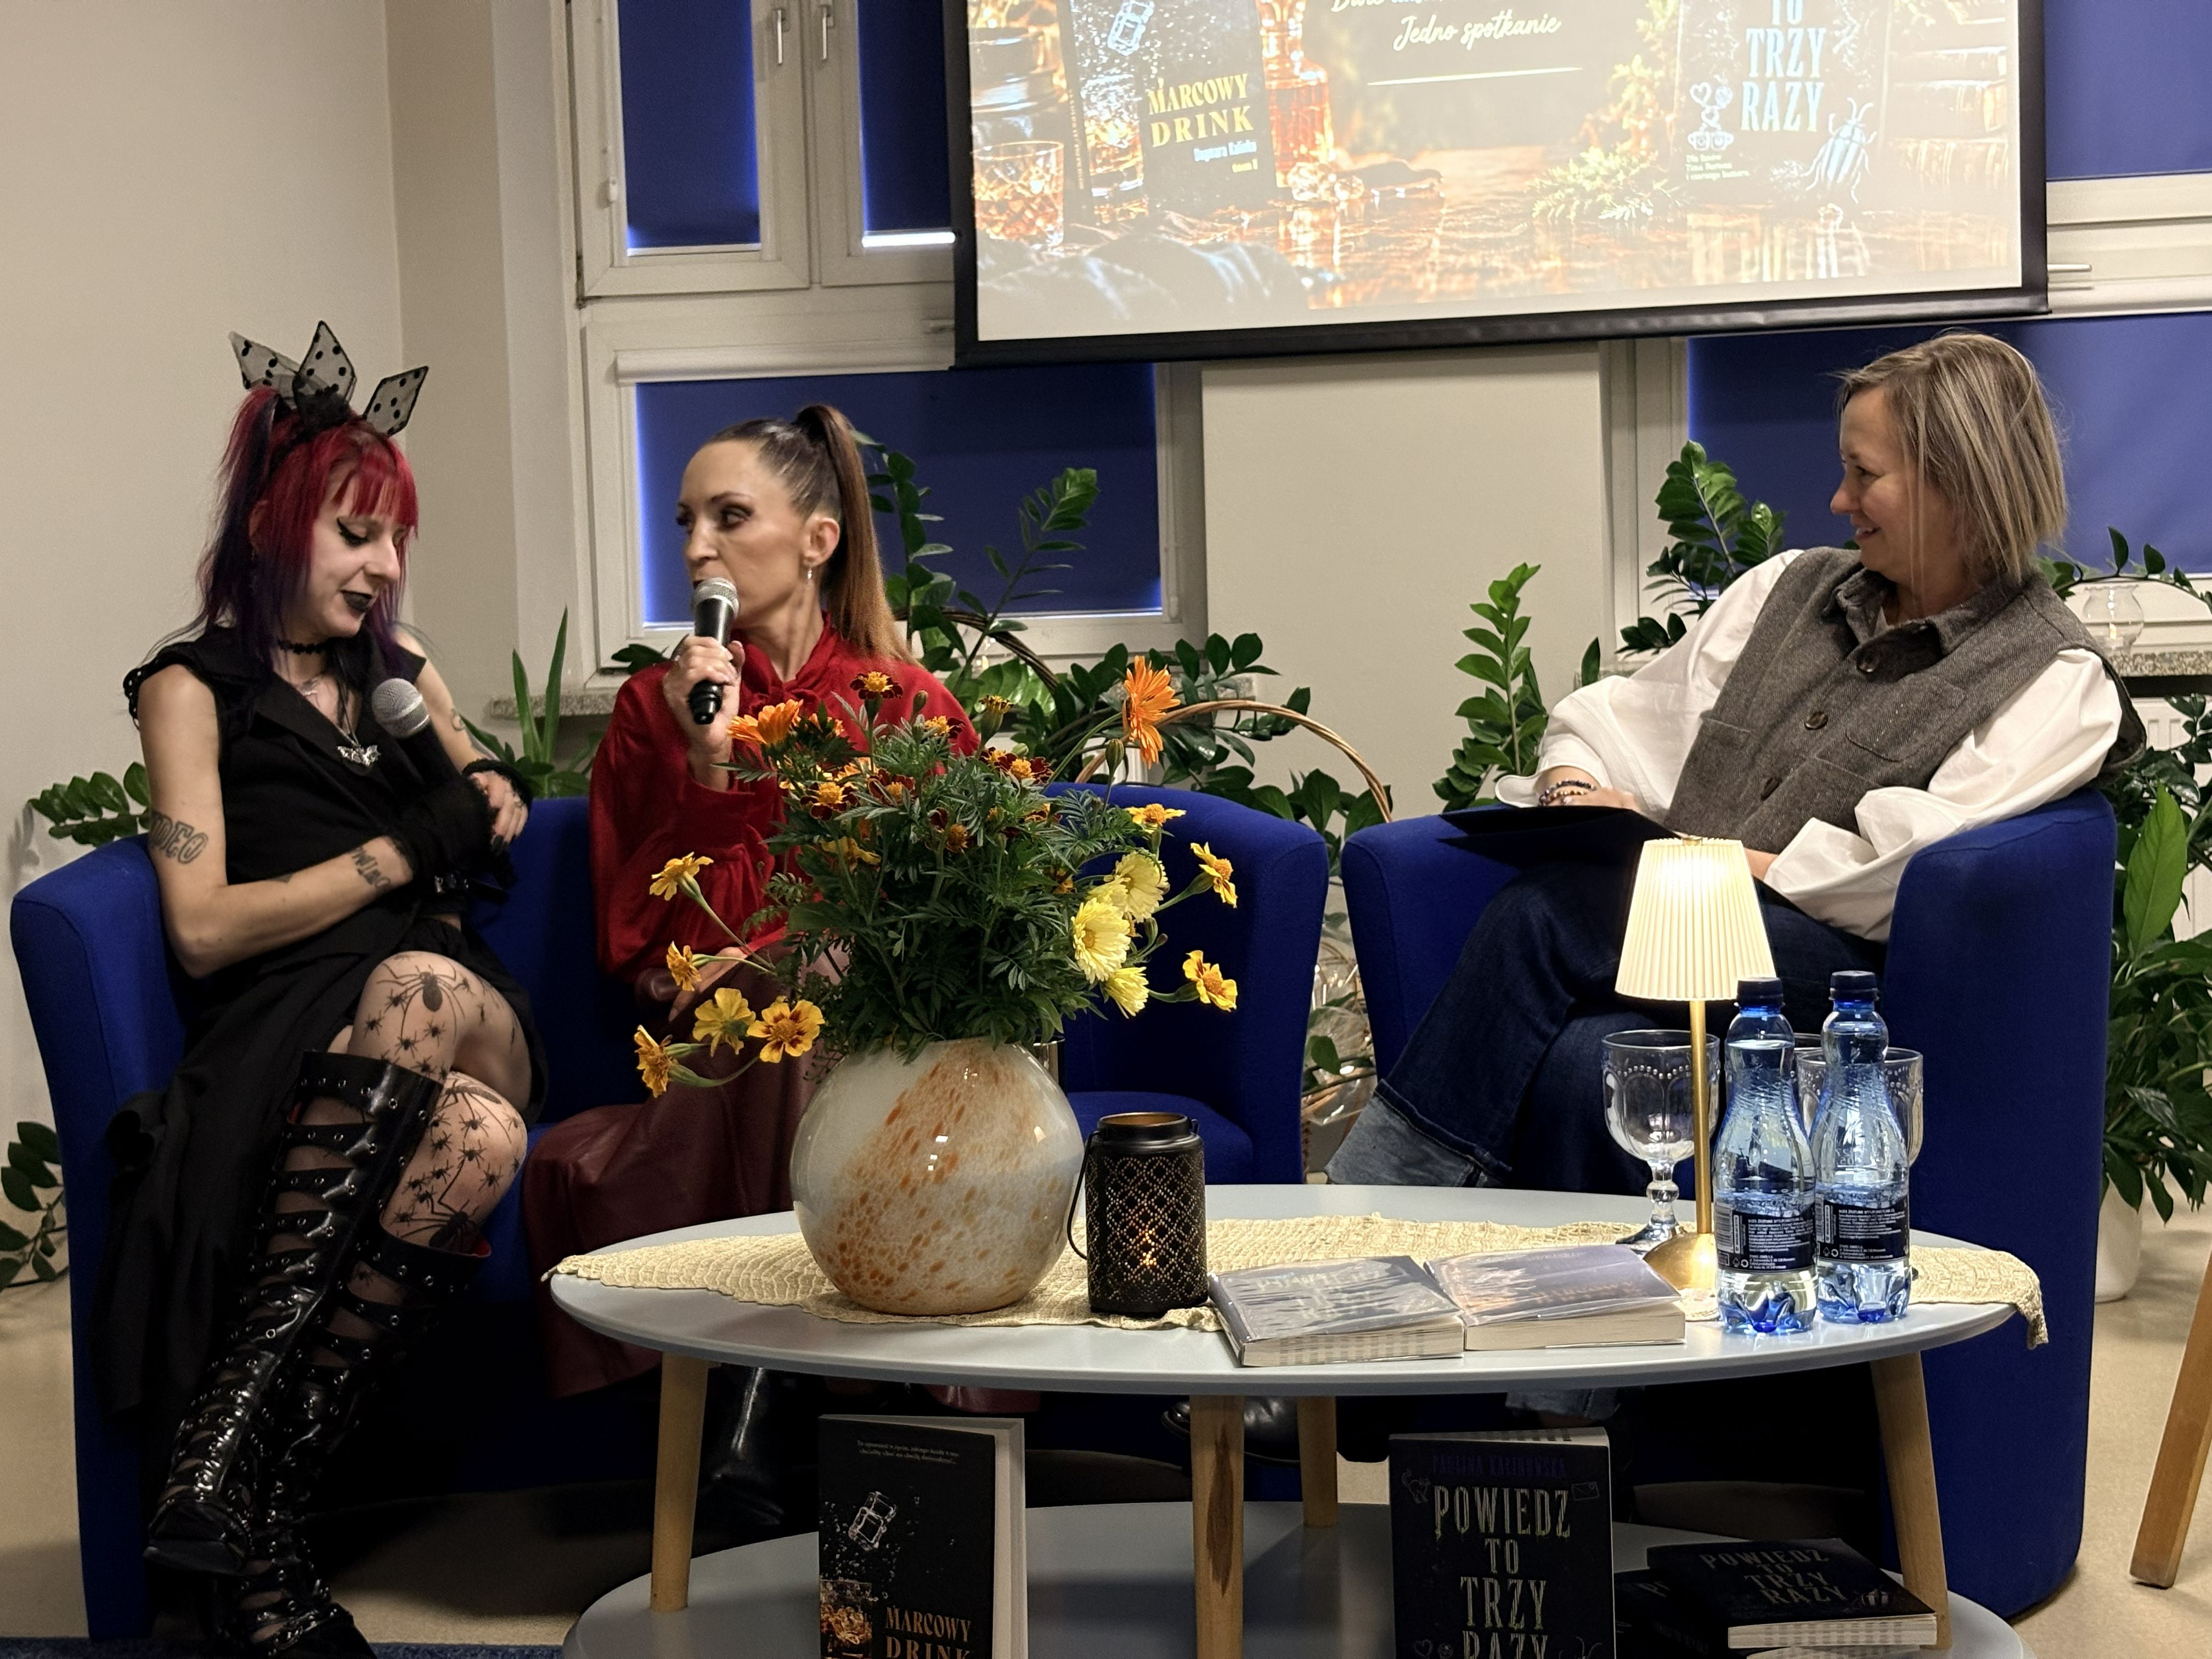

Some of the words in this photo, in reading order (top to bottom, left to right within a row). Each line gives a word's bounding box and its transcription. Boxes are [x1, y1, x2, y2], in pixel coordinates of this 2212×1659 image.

[1393, 14, 1458, 51] Jedno
[1460, 9, 1561, 50] spotkanie
[1746, 28, 1826, 78] TRZY
[1147, 74, 1248, 115] MARCOWY
[1741, 81, 1825, 132] RAZY
[1150, 106, 1254, 148] DRINK
[1434, 1486, 1571, 1540] POWIEDZ
[1485, 1538, 1520, 1574] TO
[1699, 1549, 1829, 1570] POWIEDZ
[1756, 1564, 1796, 1575] TO
[1743, 1572, 1829, 1589] TRZY
[1759, 1586, 1847, 1605] RAZY
[885, 1606, 970, 1642] MARCOWY
[1460, 1577, 1547, 1630] TRZY
